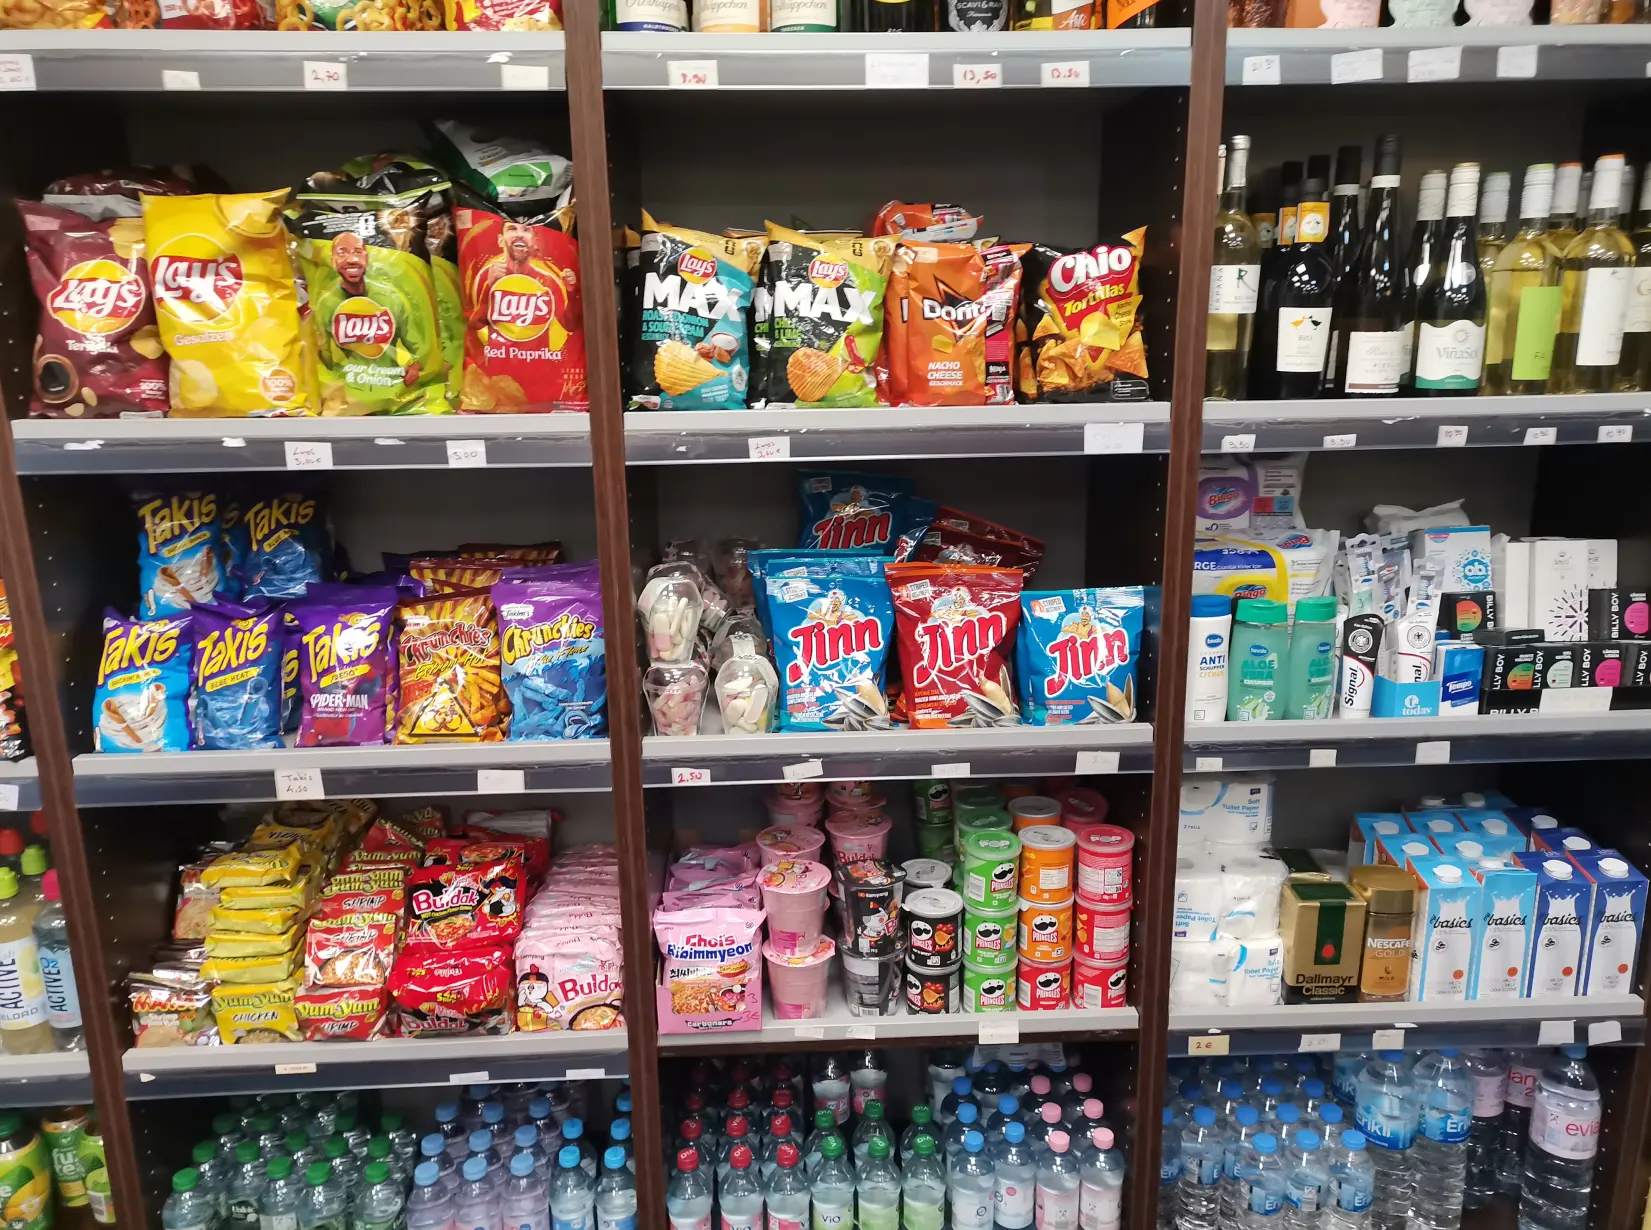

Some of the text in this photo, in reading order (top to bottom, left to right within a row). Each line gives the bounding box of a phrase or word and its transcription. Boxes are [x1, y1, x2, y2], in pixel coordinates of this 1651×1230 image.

[680, 254, 716, 276] Lay's
[811, 260, 848, 281] Lay's
[1050, 245, 1133, 293] Chio
[154, 255, 239, 303] Lay's
[53, 278, 144, 319] Lay's
[643, 271, 744, 322] MAX
[774, 280, 877, 325] MAX
[1064, 283, 1125, 317] Tortillas
[491, 290, 551, 327] Lay's
[338, 311, 391, 345] Lay's
[484, 346, 563, 363] Red Paprika
[928, 361, 961, 370] NACHO
[356, 374, 393, 387] Onion
[927, 371, 964, 379] CHEESE
[138, 494, 217, 554] Takis
[244, 499, 316, 552] Takis
[1194, 561, 1216, 570] RGE
[1486, 594, 1495, 619] BILLY
[1611, 592, 1620, 639] BILLY BOY
[97, 622, 182, 687] Takis
[198, 623, 269, 687] Takis
[788, 617, 882, 684] Jinn
[915, 611, 1003, 686] Jinn
[1046, 629, 1129, 696] Jinn
[1200, 655, 1225, 666] ANTI
[1492, 653, 1506, 690] LLY BOY
[1533, 650, 1544, 689] LLY BOY
[1581, 648, 1592, 687] LLY BOY
[1635, 650, 1648, 686] LLY BOY
[210, 670, 251, 689] BLUE HEAT
[1412, 664, 1422, 683] nal
[1344, 667, 1359, 707] Signal
[1446, 680, 1473, 694] Tempo
[310, 693, 369, 710] SPIDER-MAN
[1402, 704, 1433, 716] today
[1433, 916, 1474, 929] basics
[1487, 914, 1528, 926] basics
[975, 937, 1001, 950] PRINGLES
[1032, 932, 1059, 943] PRINGLES
[1375, 949, 1405, 958] GOLD
[0, 957, 25, 1011] ACTIVE
[44, 968, 68, 1012] ACTIVE
[558, 974, 623, 1003] Buldak
[1295, 973, 1354, 985] Dallmayr
[1302, 985, 1346, 996] Classic
[980, 995, 1005, 1006] PRINGLES
[1036, 987, 1061, 999] PRINGLES
[232, 1011, 279, 1023] CHICKEN
[1446, 1118, 1471, 1133] Eri
[821, 1214, 841, 1224] ViO
